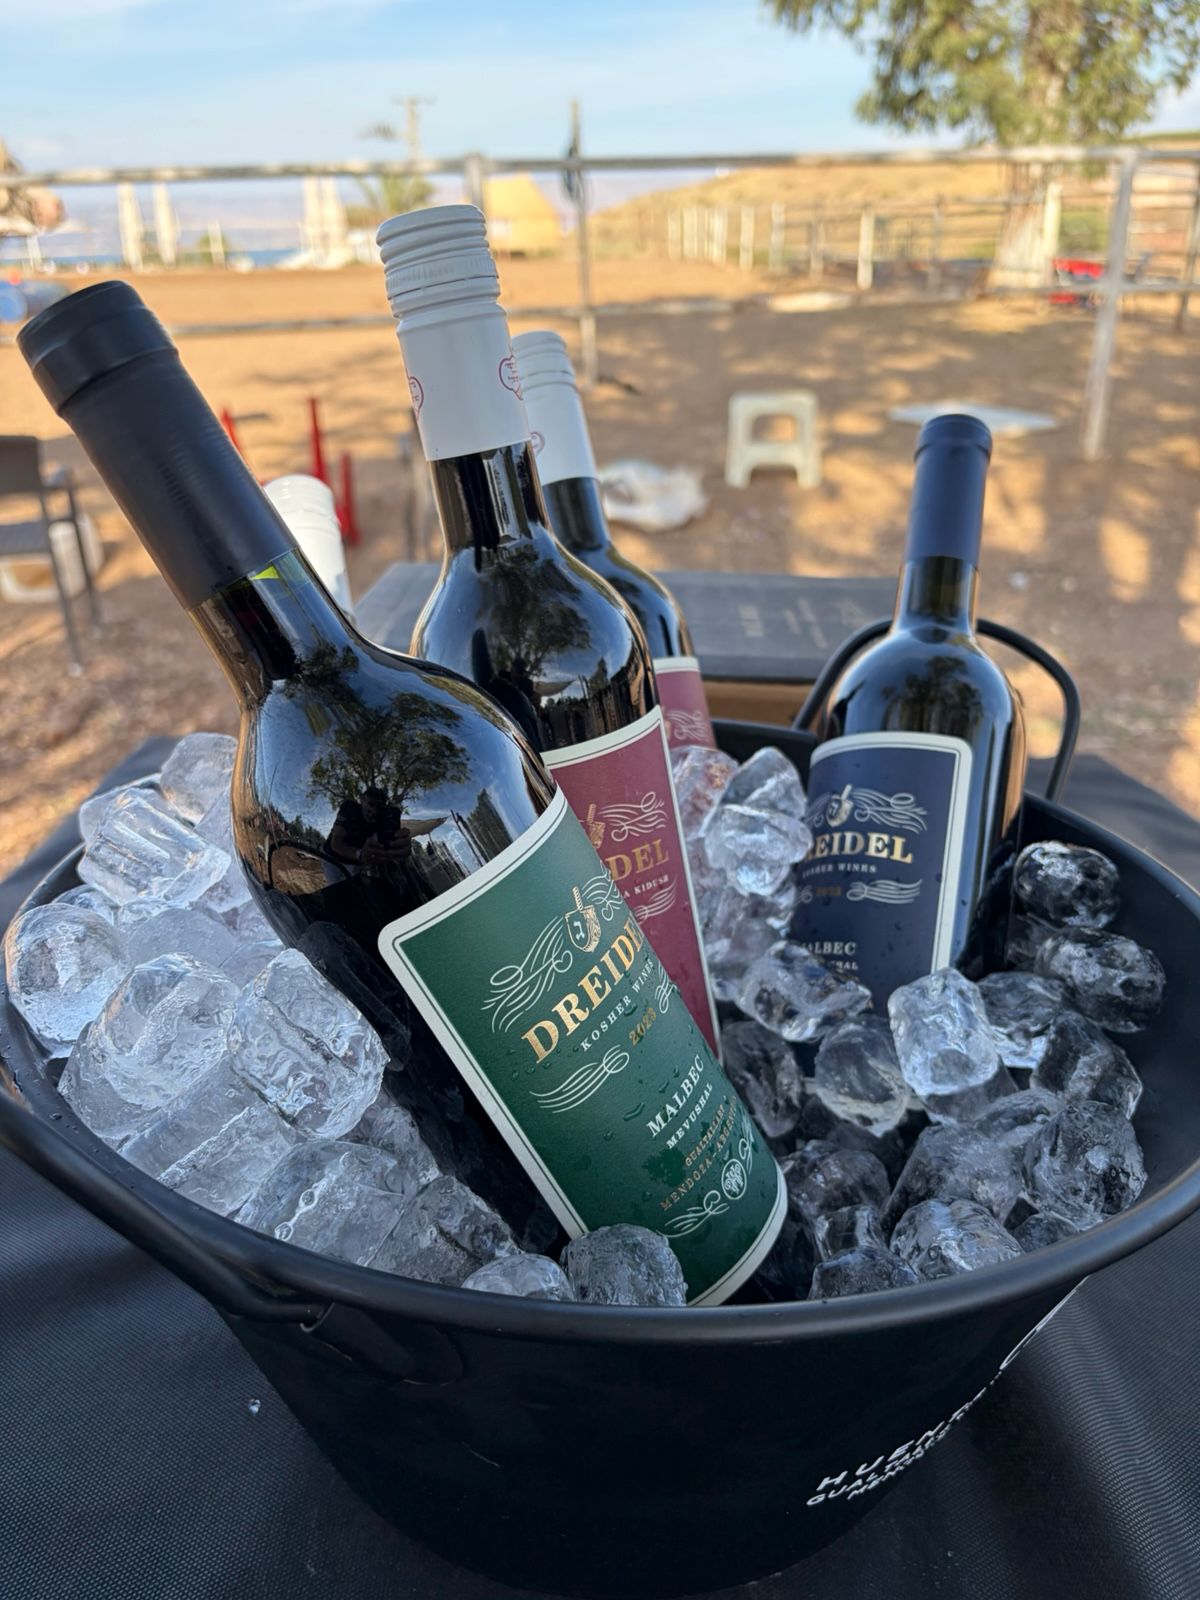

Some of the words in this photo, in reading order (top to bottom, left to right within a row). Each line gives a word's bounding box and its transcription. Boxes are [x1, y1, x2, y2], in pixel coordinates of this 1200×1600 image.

[605, 839, 669, 881] DEL
[634, 874, 669, 895] KIDUSH
[801, 941, 857, 956] ALBEC
[580, 995, 632, 1052] KOSHER
[631, 958, 655, 993] WINES
[645, 1053, 704, 1138] MALBEC
[666, 1082, 713, 1150] MEVUSHAL
[660, 1156, 713, 1211] MENDOZA
